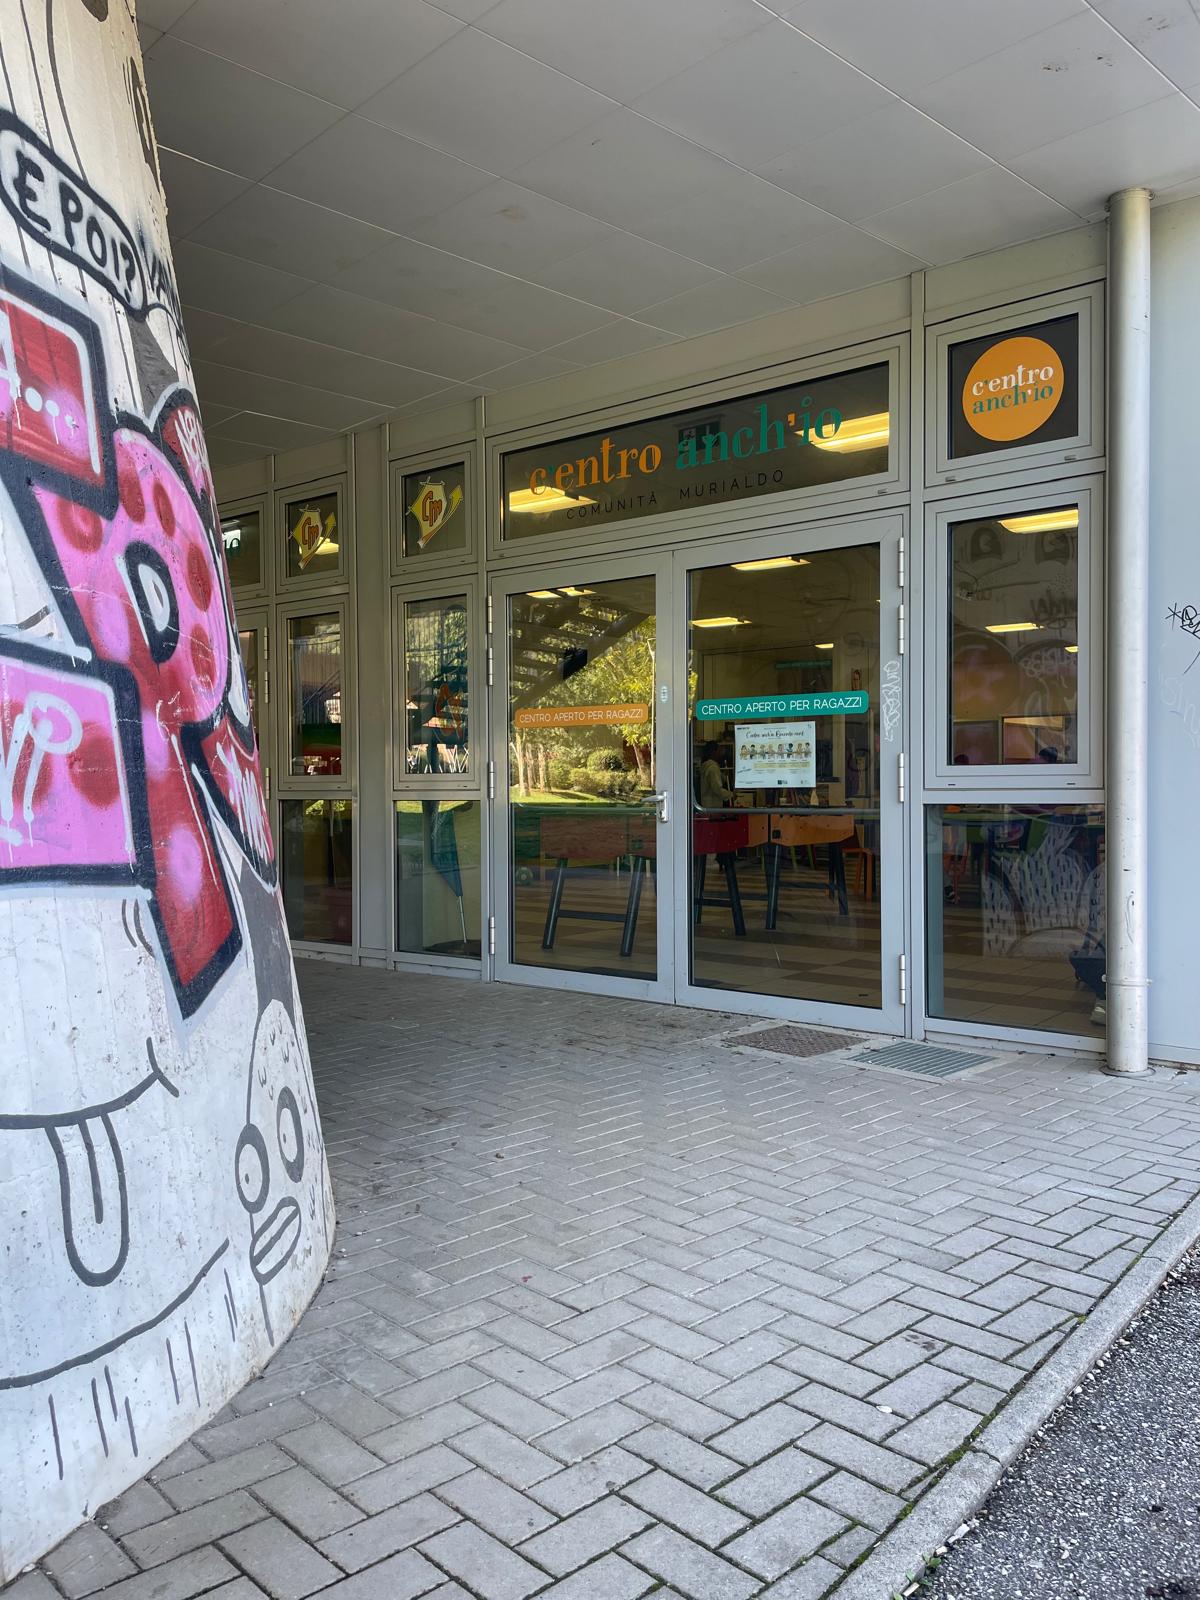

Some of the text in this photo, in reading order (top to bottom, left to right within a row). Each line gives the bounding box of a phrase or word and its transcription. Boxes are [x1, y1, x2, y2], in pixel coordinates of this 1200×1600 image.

[973, 382, 1054, 415] anch'io
[676, 395, 843, 471] anch'io
[566, 469, 784, 520] COMUNITÀ MURIALDO
[519, 708, 643, 724] CENTRO APERTO PER RAGAZZI
[701, 696, 862, 716] CENTRO APERTO PER RAGAZZI
